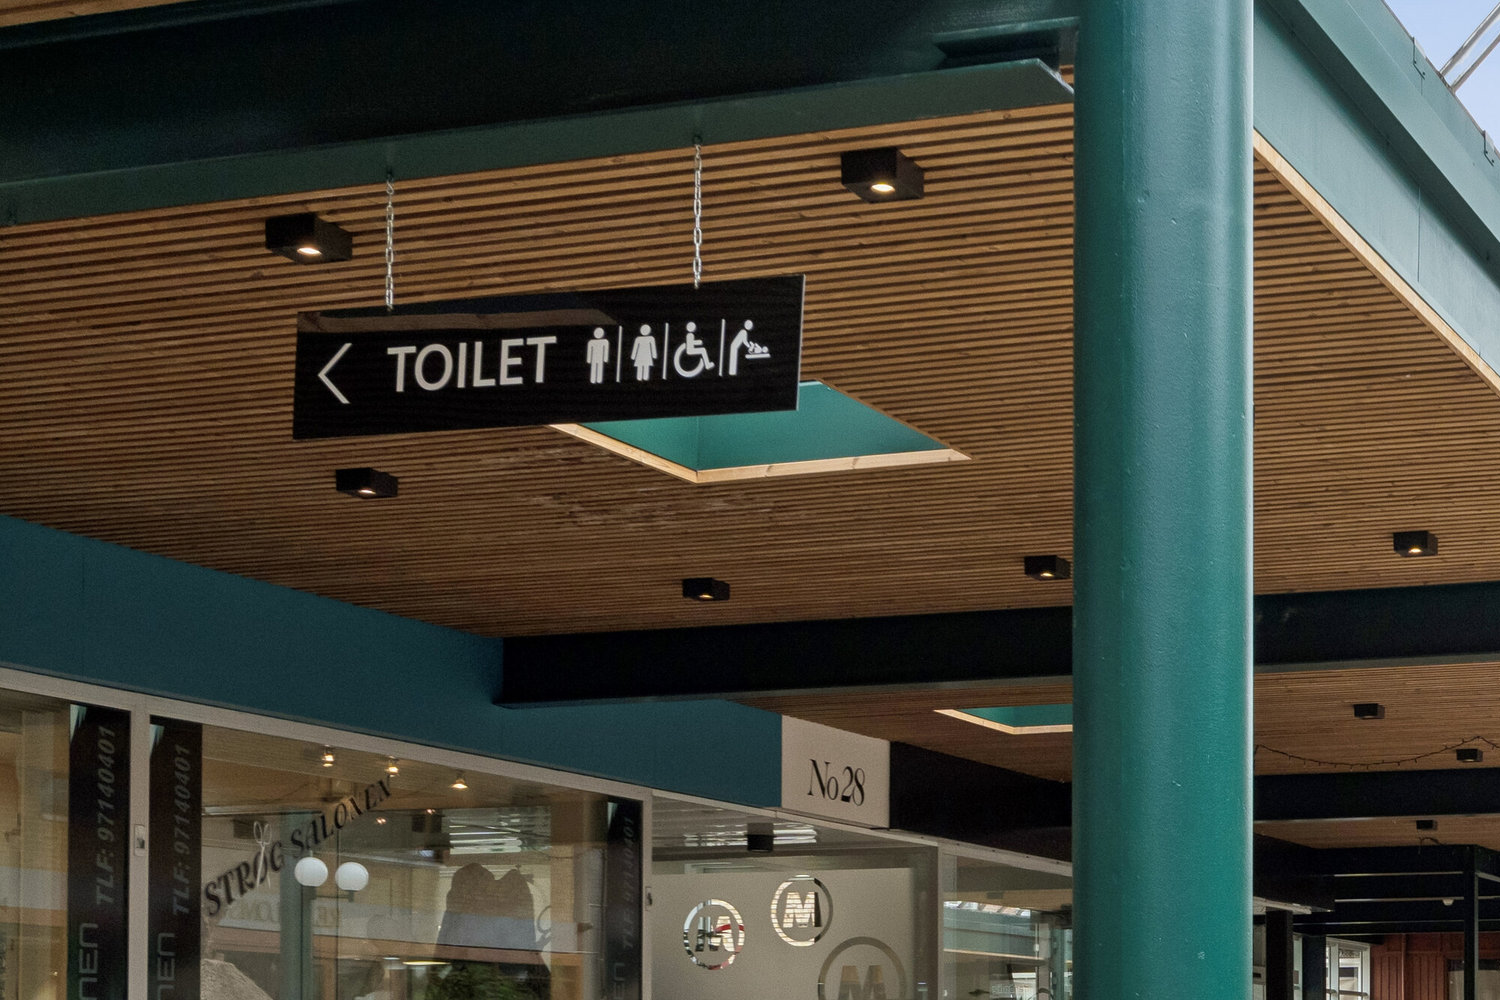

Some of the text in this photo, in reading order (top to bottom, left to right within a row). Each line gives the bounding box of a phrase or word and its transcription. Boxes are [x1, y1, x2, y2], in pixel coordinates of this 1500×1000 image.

[387, 335, 557, 393] TOILET
[97, 726, 116, 842] 97140401
[174, 743, 192, 856] 97140401
[290, 774, 393, 859] SALONEN
